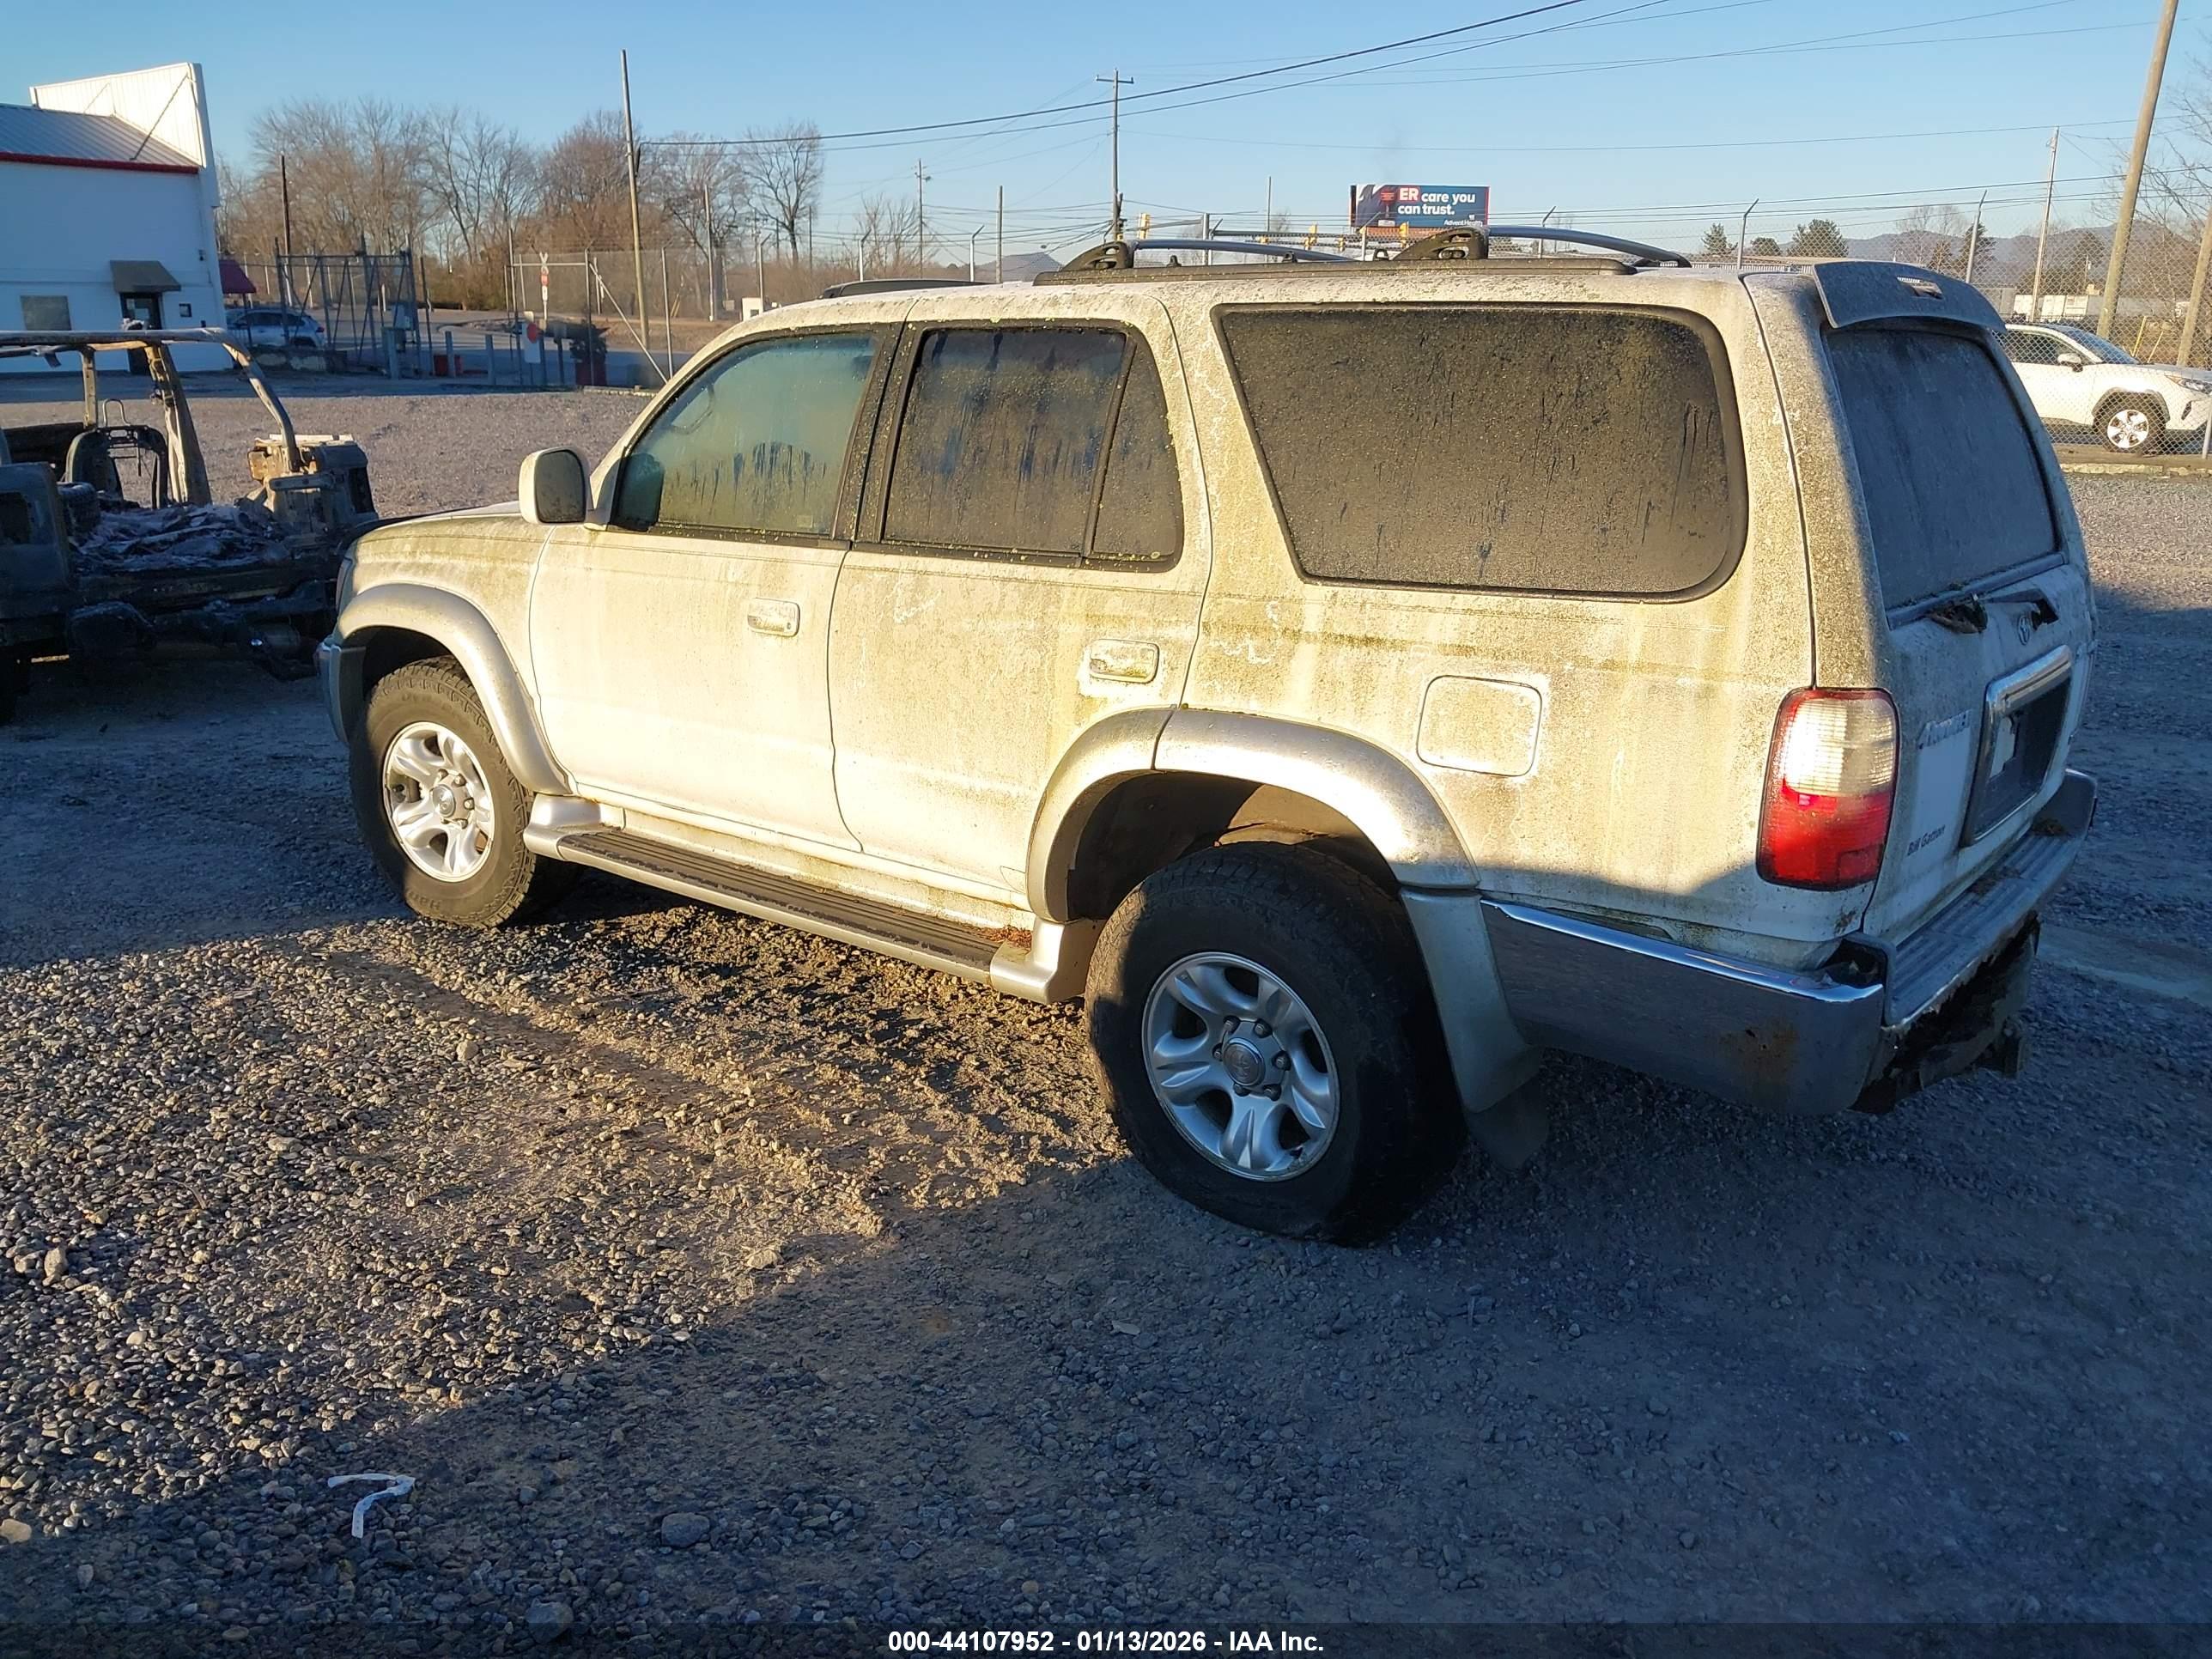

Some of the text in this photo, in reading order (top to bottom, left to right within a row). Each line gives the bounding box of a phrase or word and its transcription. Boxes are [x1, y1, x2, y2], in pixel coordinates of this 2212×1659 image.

[1399, 187, 1419, 201] ER
[1421, 192, 1449, 203] care
[1452, 193, 1475, 205] you
[1398, 204, 1455, 216] can trust.
